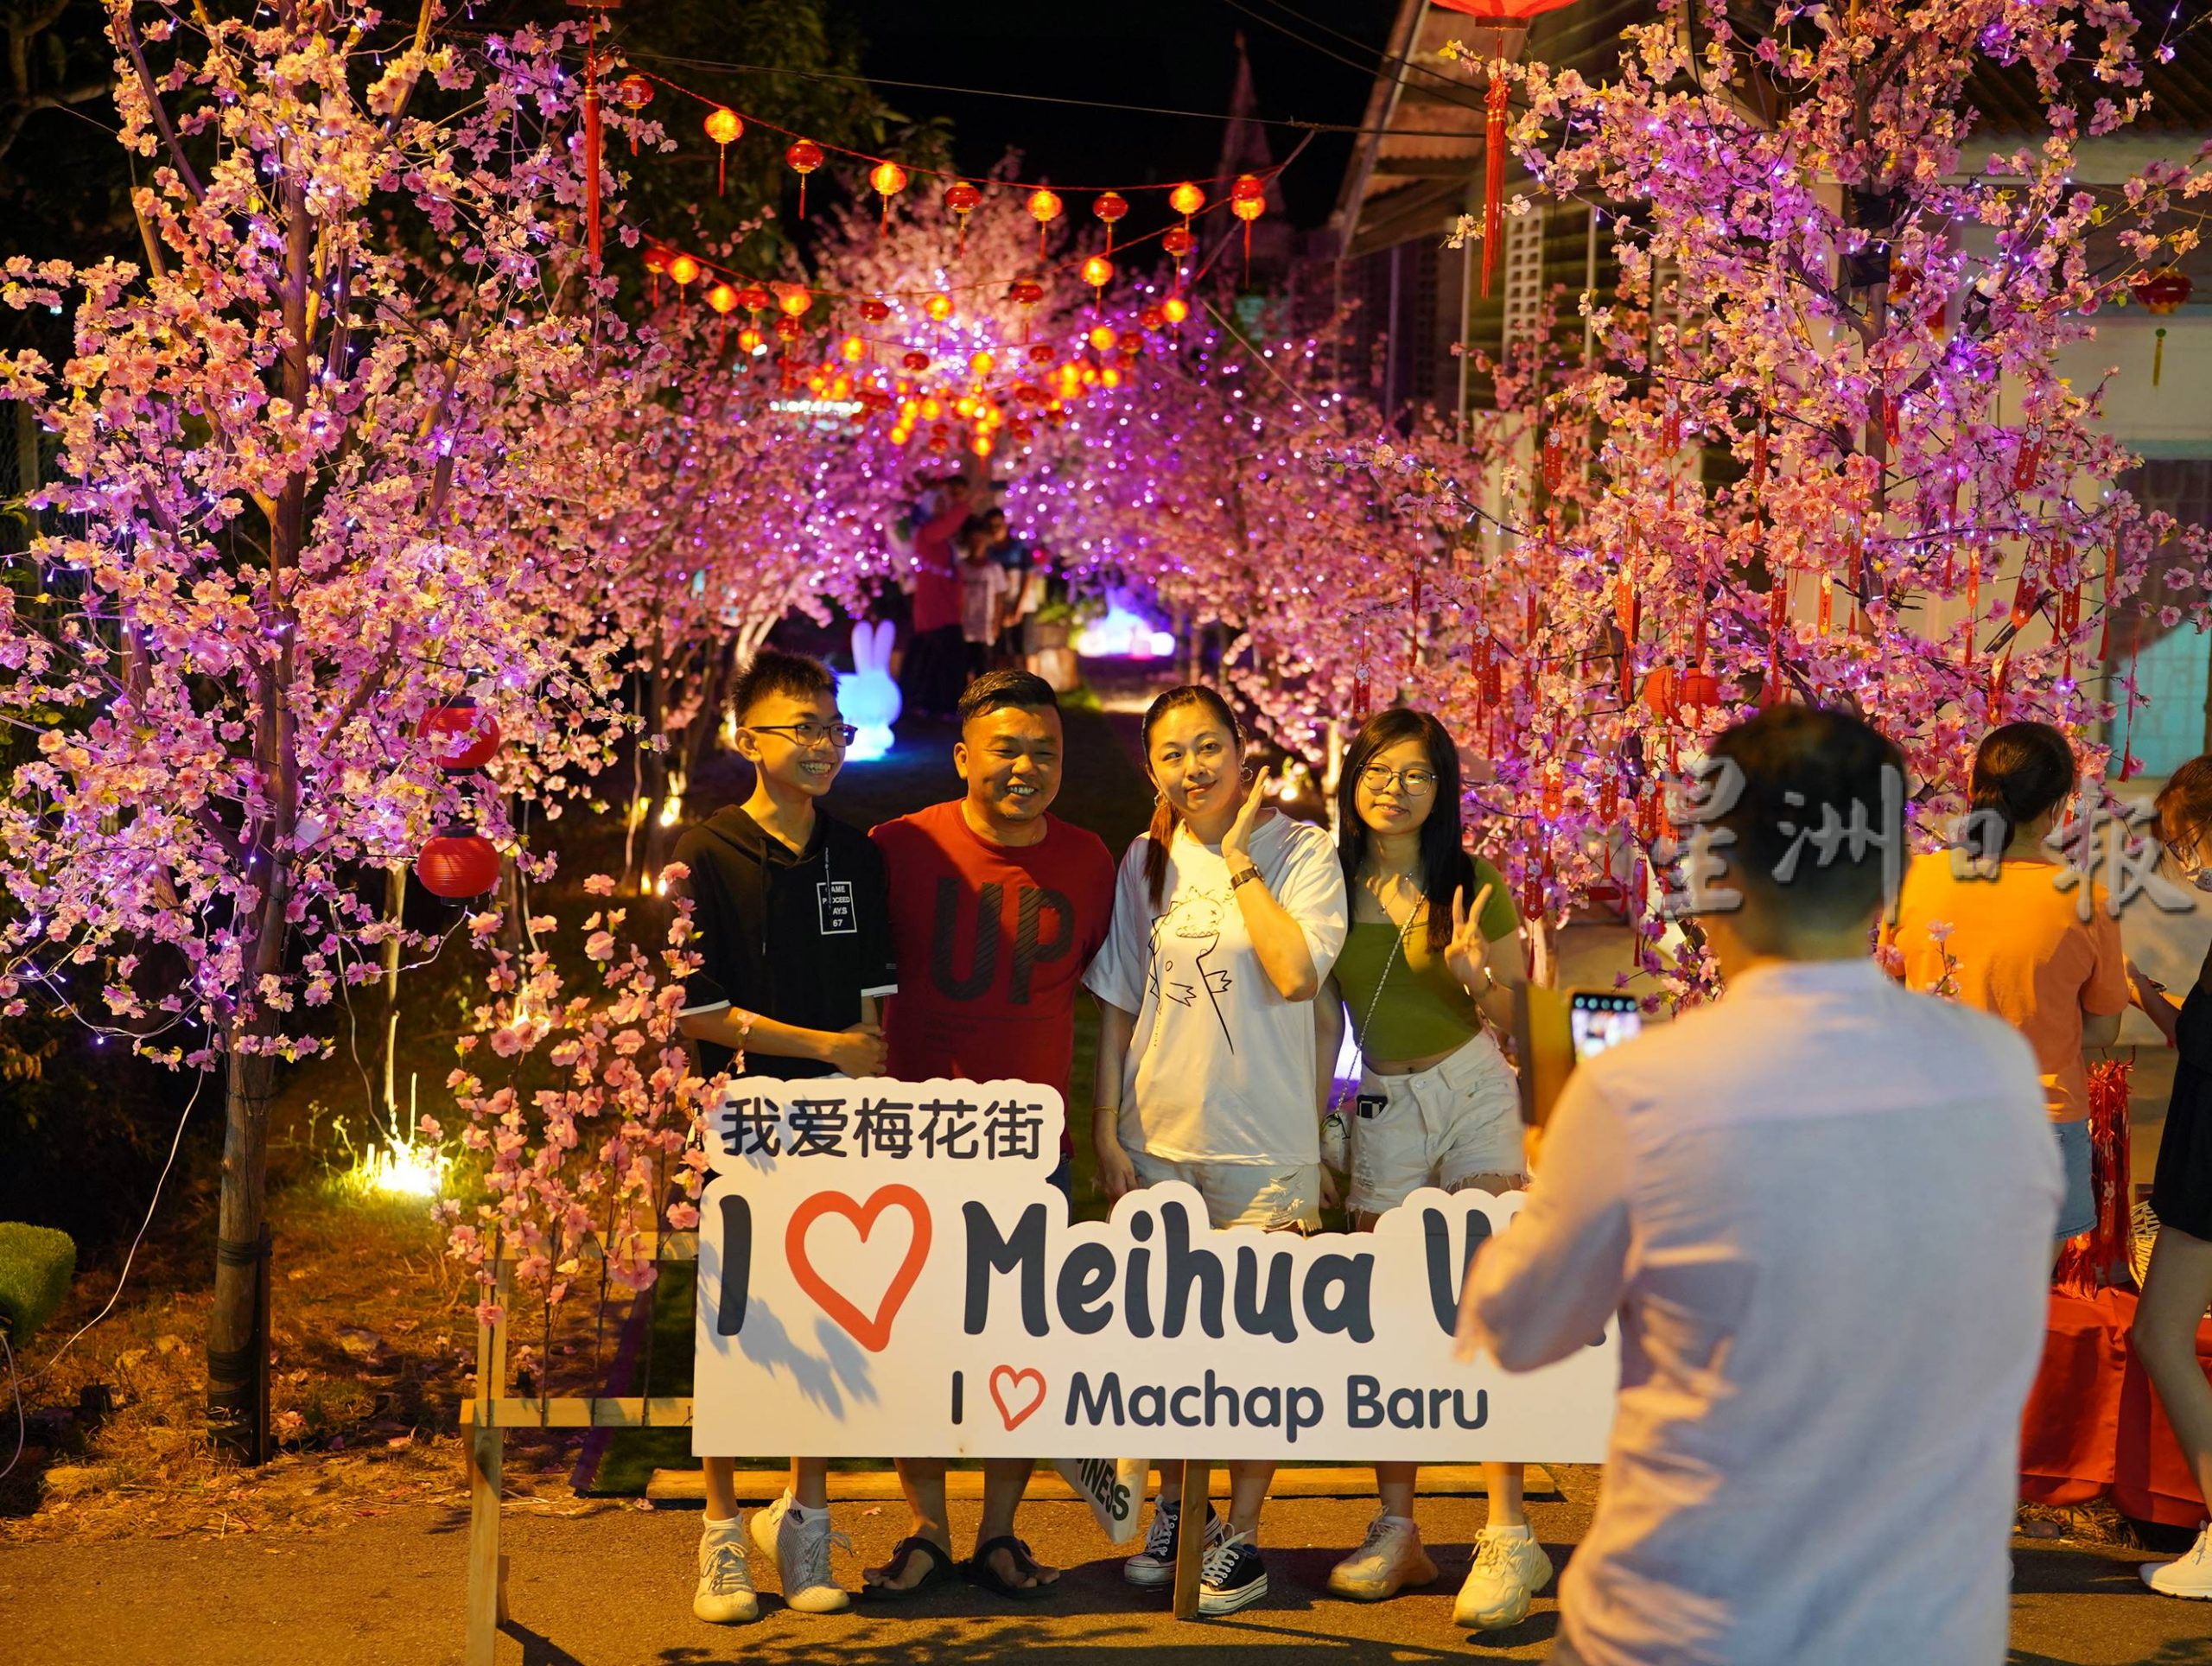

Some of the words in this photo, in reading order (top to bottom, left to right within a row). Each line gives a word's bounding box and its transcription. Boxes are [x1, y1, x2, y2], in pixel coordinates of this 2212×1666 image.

[931, 876, 1074, 1005] UP
[721, 1097, 1044, 1160] 我爱梅花街
[716, 1194, 752, 1337] I
[962, 1200, 1375, 1344] Meihua
[951, 1370, 963, 1425] I
[1065, 1369, 1324, 1443] Machap
[1347, 1375, 1488, 1430] Baru
[1076, 1458, 1131, 1522] INESS
